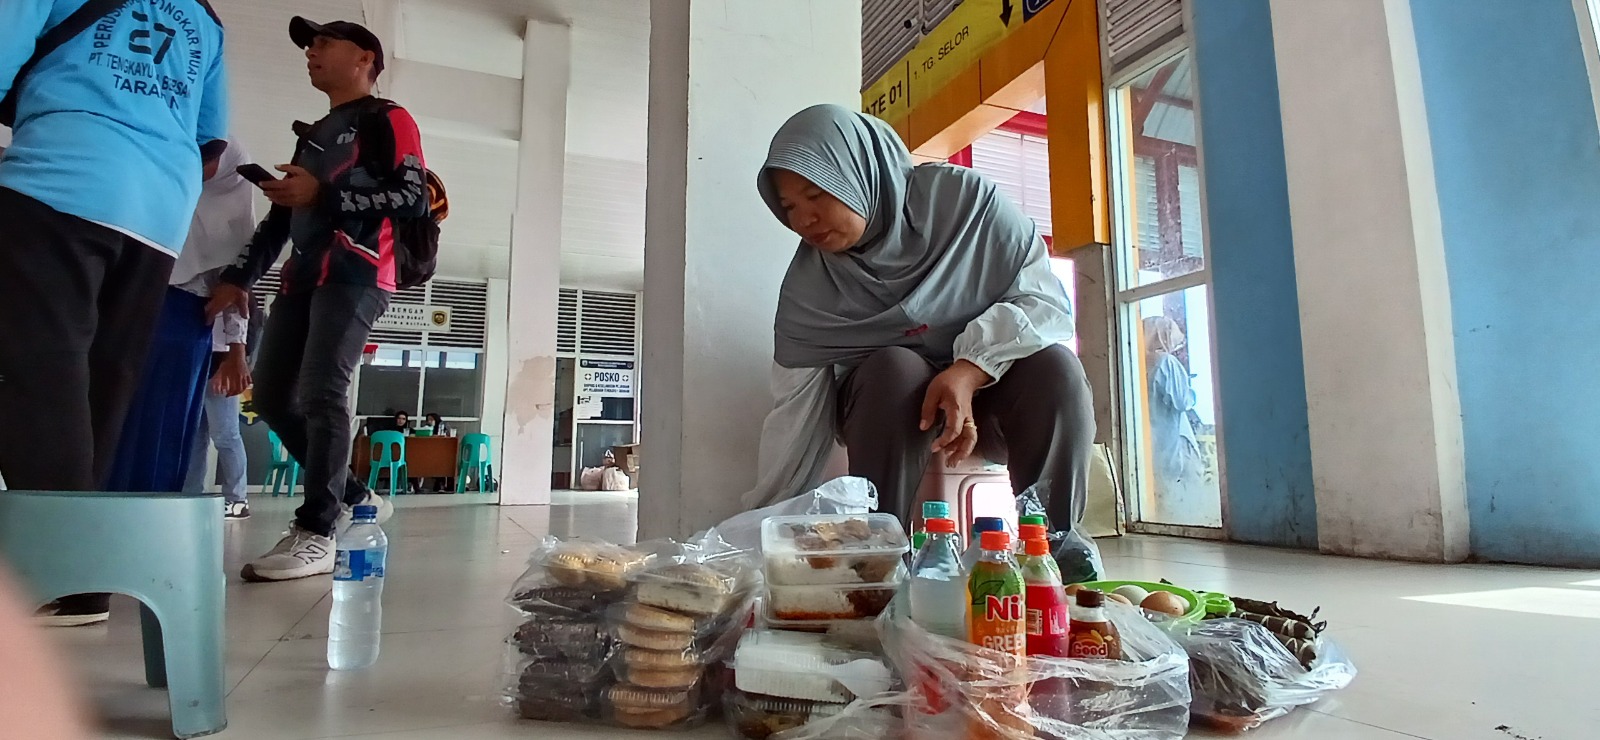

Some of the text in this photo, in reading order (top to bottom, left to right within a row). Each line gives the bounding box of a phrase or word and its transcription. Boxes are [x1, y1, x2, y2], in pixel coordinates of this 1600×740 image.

[128, 10, 176, 64] 27
[922, 59, 936, 74] TG.
[938, 25, 970, 61] SELOR
[107, 53, 153, 79] TENGKAYU
[187, 49, 201, 84] MUAT
[889, 80, 902, 105] 01
[594, 372, 620, 382] POSKO
[1072, 641, 1109, 658] Good
